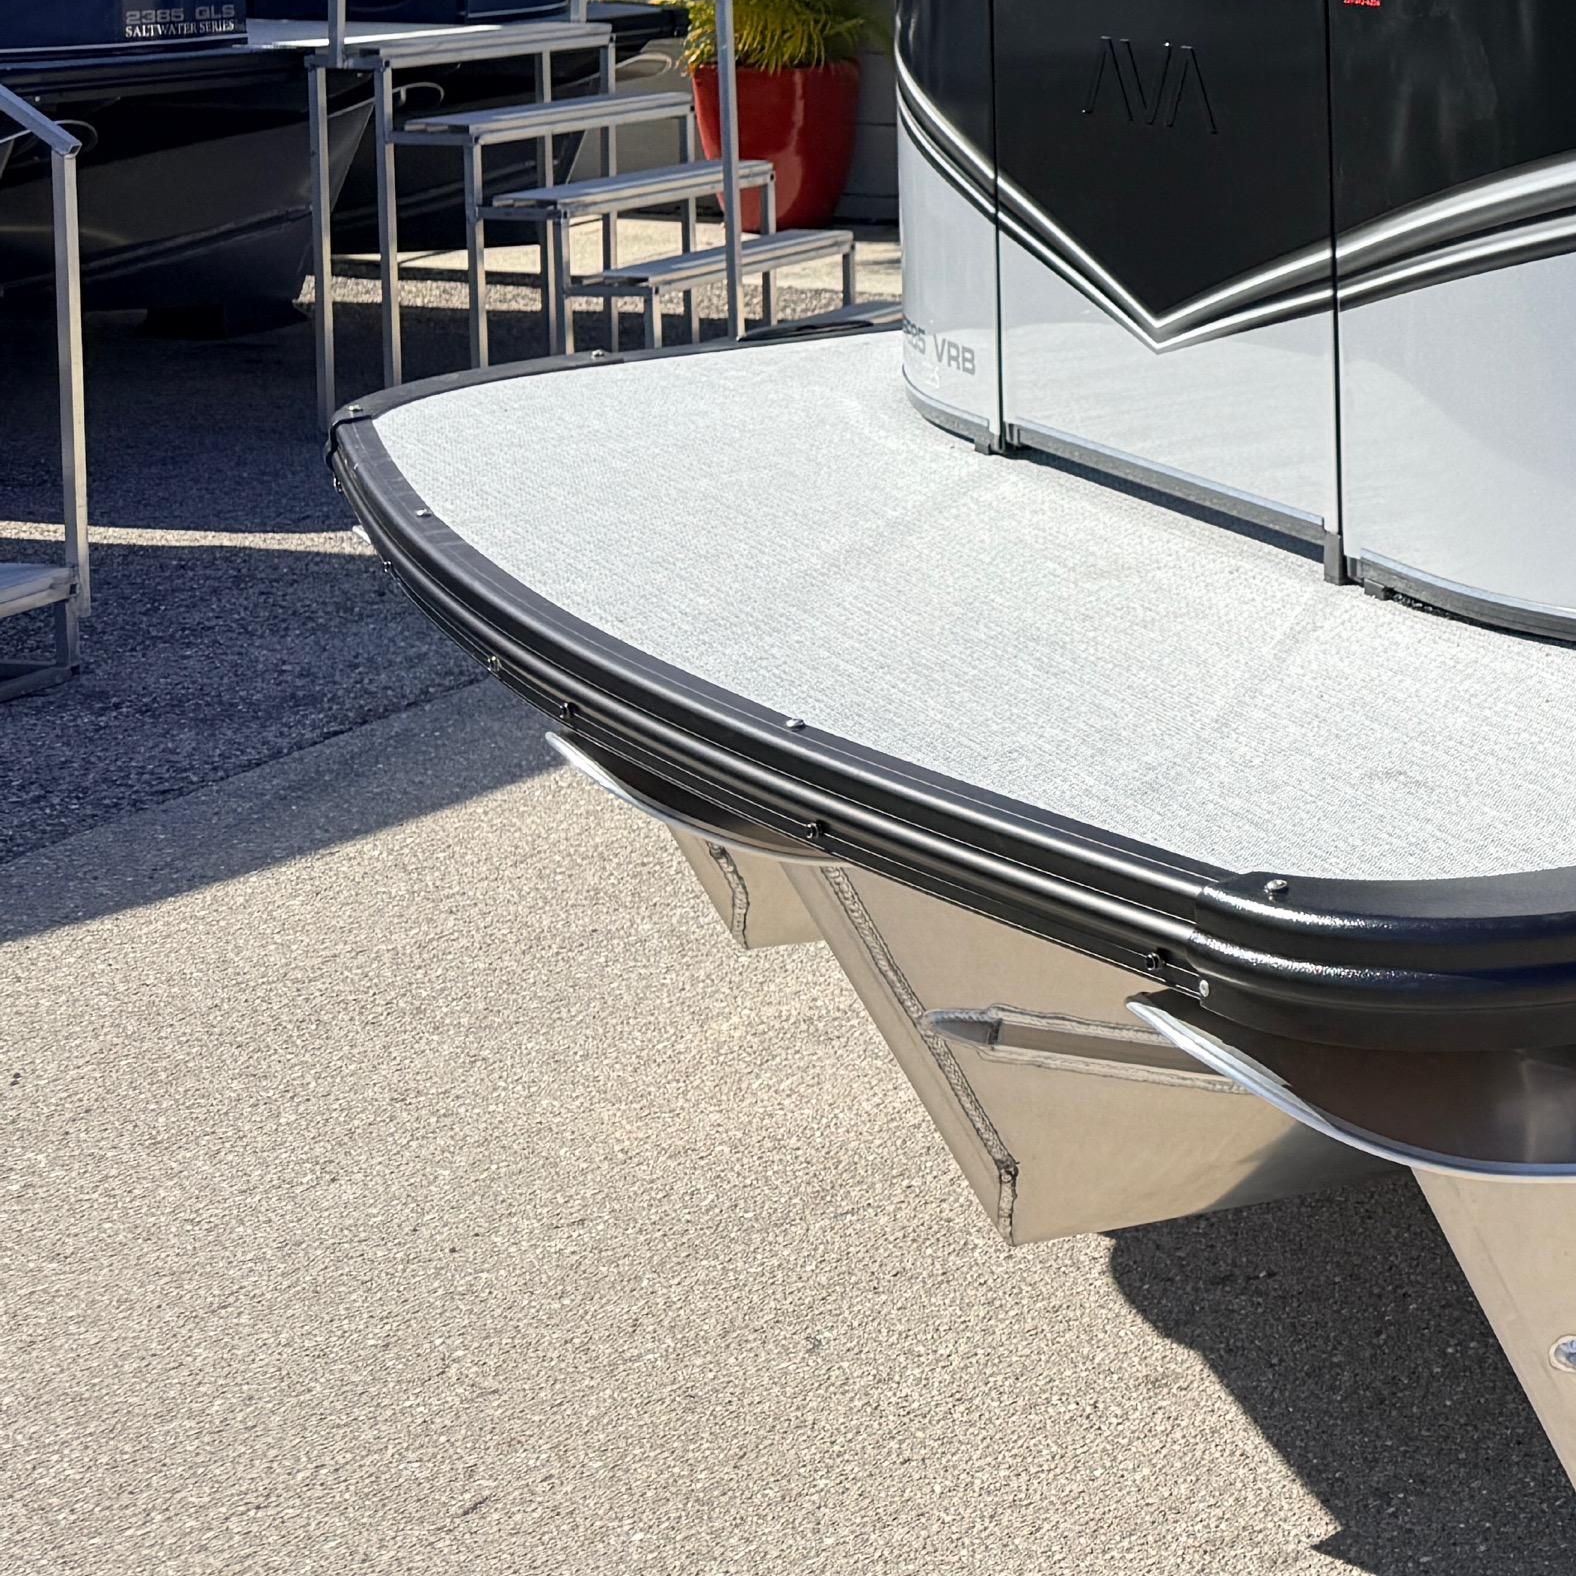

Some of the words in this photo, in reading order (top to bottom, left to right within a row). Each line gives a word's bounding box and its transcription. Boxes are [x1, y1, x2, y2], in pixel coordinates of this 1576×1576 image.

[125, 22, 197, 38] SALTWATER
[199, 19, 235, 33] SERIES
[1082, 35, 1219, 135] AVA
[933, 332, 976, 375] VRB
